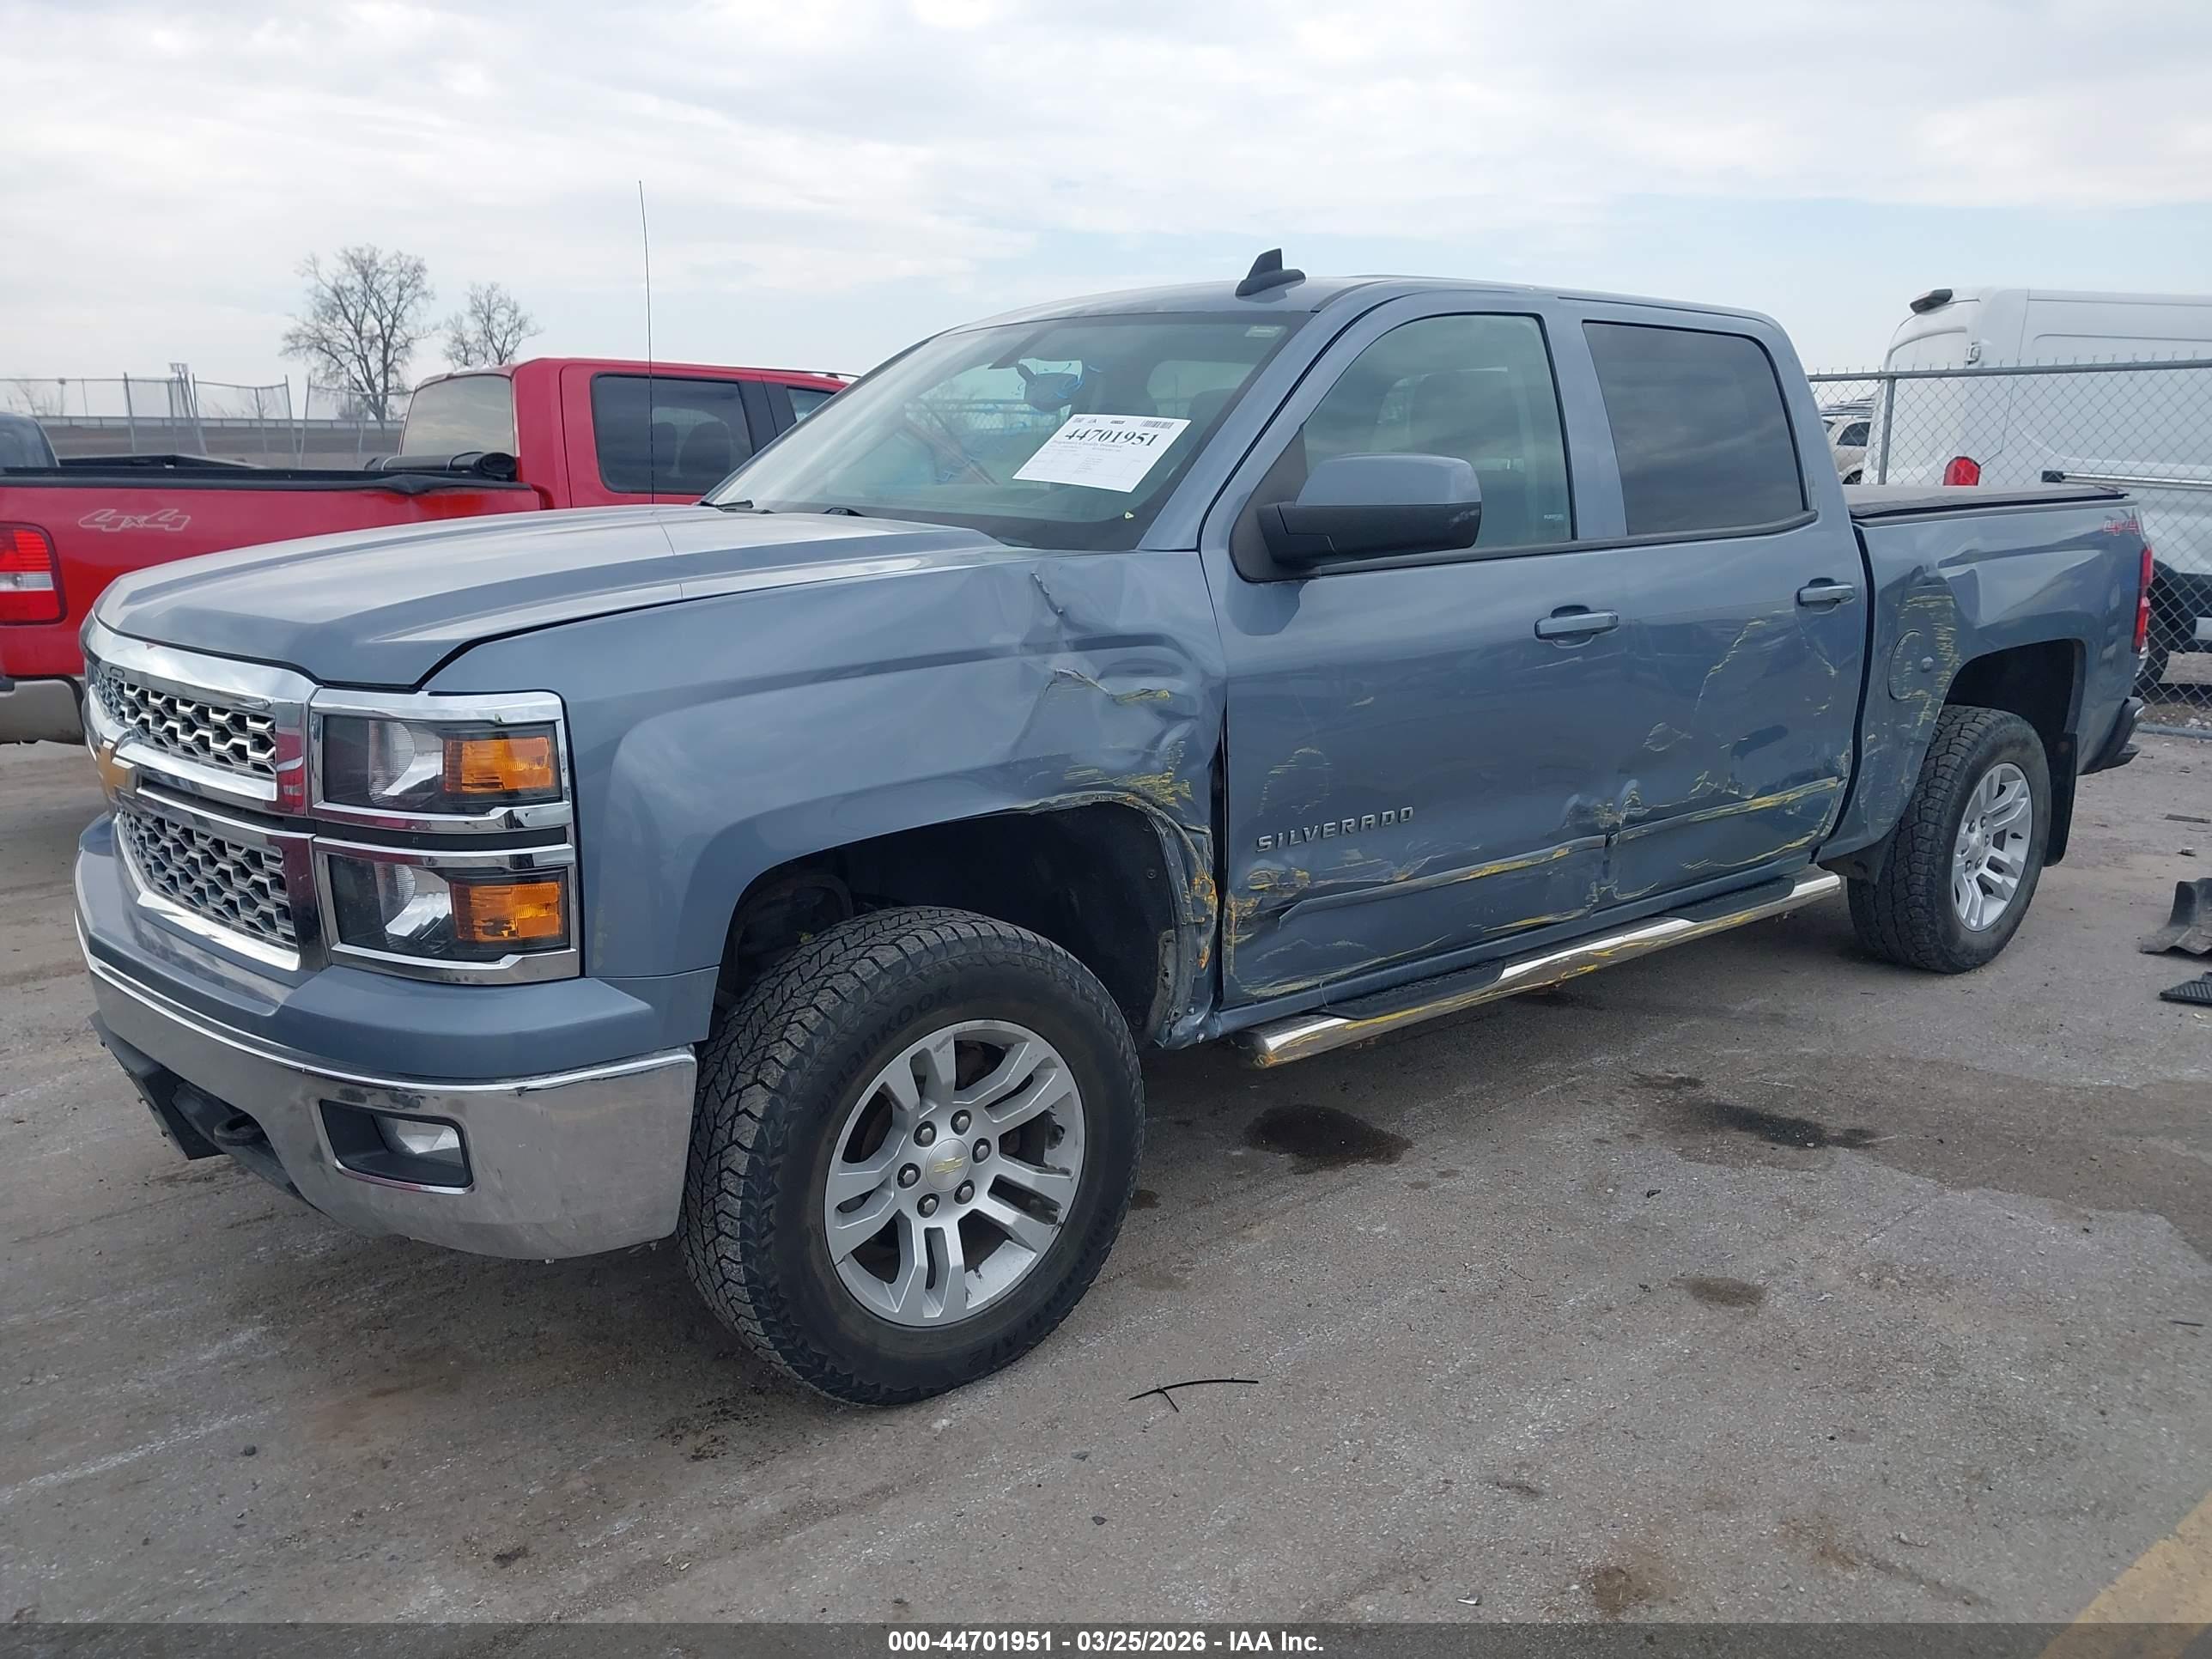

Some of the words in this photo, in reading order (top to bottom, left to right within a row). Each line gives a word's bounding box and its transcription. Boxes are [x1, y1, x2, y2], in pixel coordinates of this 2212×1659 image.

[1065, 428, 1158, 447] 44701951
[78, 508, 191, 532] 4x4
[1255, 806, 1413, 853] SILVERADO
